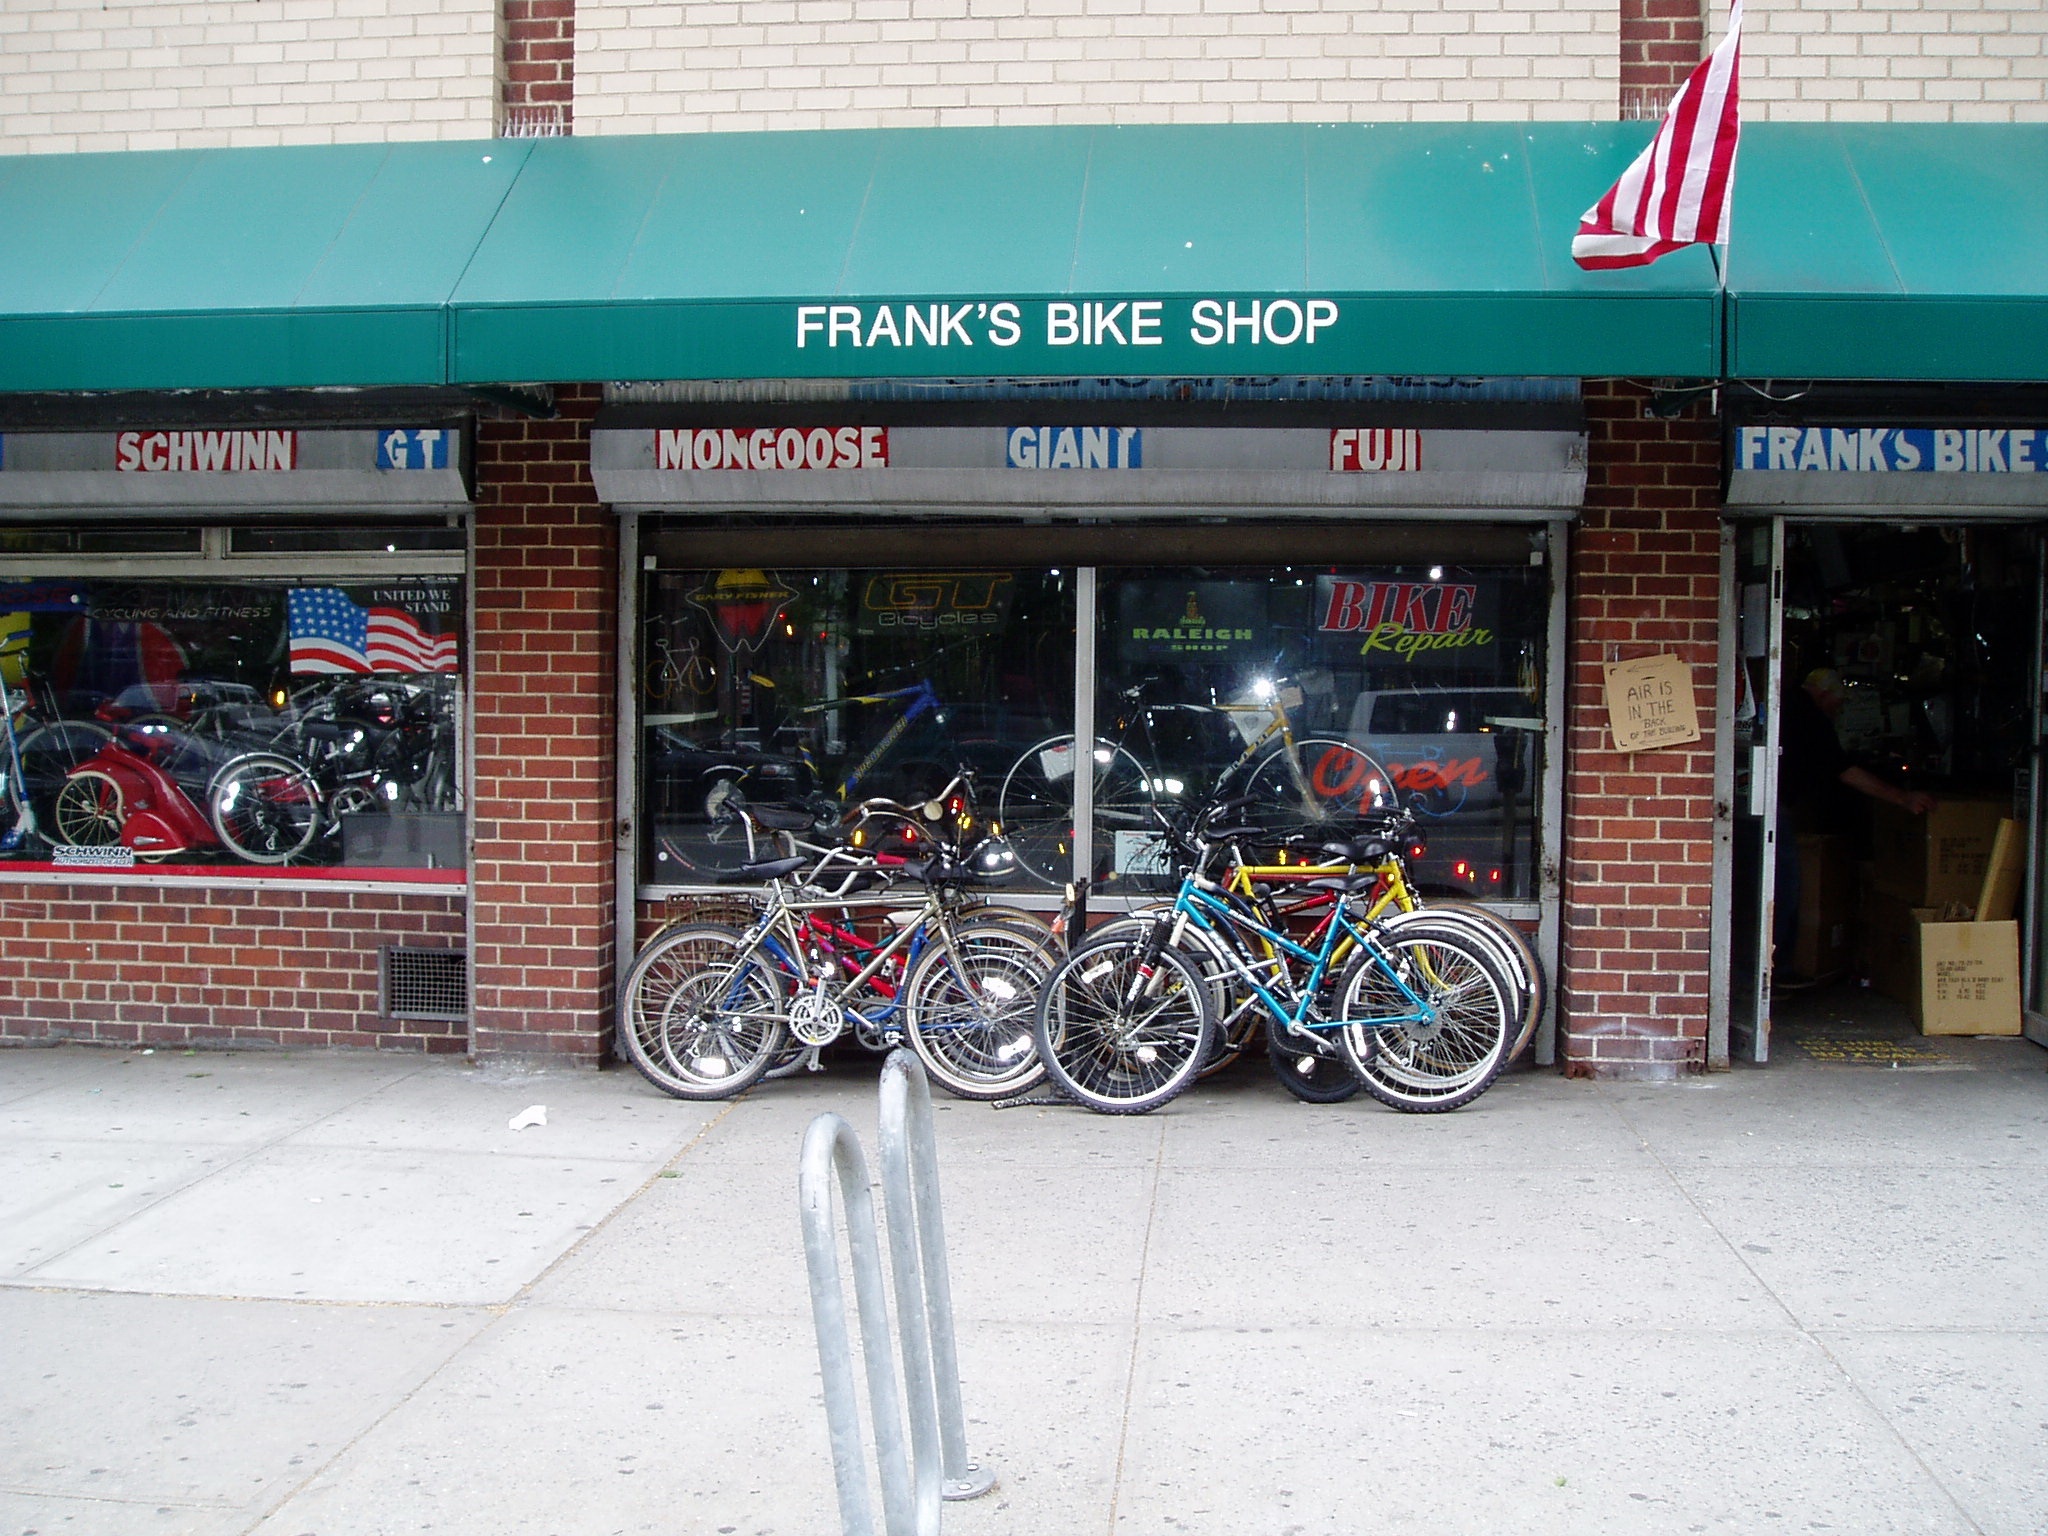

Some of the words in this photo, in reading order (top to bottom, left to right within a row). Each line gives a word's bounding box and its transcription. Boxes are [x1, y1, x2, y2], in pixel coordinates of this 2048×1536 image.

[797, 302, 1021, 348] FRANK'S
[1046, 301, 1163, 346] BIKE
[1190, 299, 1338, 346] SHOP
[117, 430, 294, 471] SCHWINN
[382, 429, 440, 469] GT
[659, 427, 887, 469] MONGOOSE
[1009, 426, 1137, 469] GIANT
[1332, 428, 1418, 471] FUJI
[1741, 427, 1921, 471] FRANK'S
[1934, 429, 2036, 472] BIKE
[373, 590, 426, 601] UNITED
[428, 589, 451, 601] WE
[404, 602, 451, 613] STAND
[1319, 580, 1477, 634] BIKE
[92, 608, 158, 619] CYCLING
[161, 607, 198, 619] AND
[204, 607, 272, 618] FITNESS
[878, 611, 999, 630] Bicycles
[1132, 628, 1253, 640] RALEIGH
[1170, 644, 1229, 652] SHOP
[1360, 621, 1494, 663] Repair
[1627, 684, 1652, 701] AIR
[1659, 681, 1673, 695] IS
[1628, 704, 1642, 720] IN
[1646, 699, 1676, 716] THE
[1641, 718, 1666, 729] BACK
[1312, 745, 1488, 815] Open
[54, 846, 132, 857] SCHWINN
